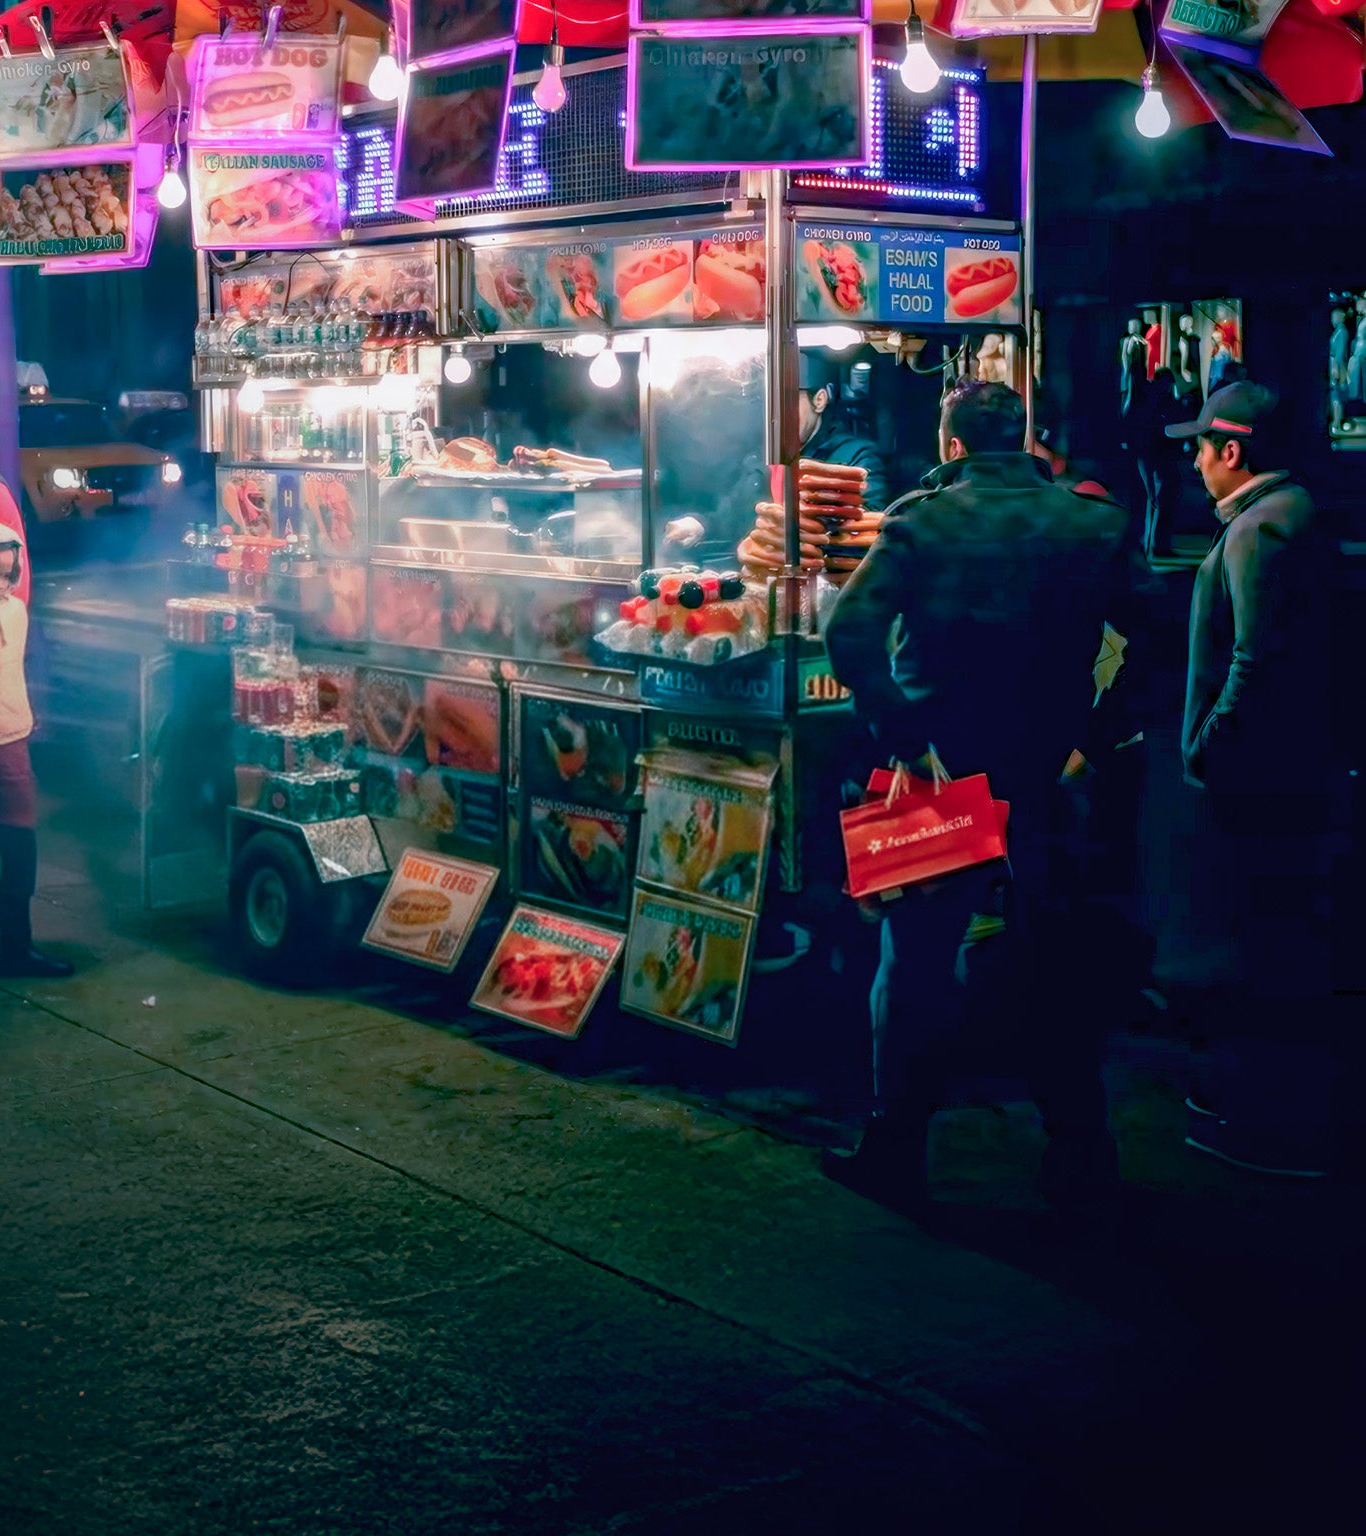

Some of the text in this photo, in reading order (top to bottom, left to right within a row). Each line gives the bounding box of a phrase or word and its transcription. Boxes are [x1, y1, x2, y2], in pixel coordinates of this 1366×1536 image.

[270, 49, 328, 68] DOG
[261, 154, 325, 169] SAUSAGE
[885, 249, 938, 268] ESAM'S
[889, 272, 934, 290] HALAL
[891, 294, 933, 313] FOOD
